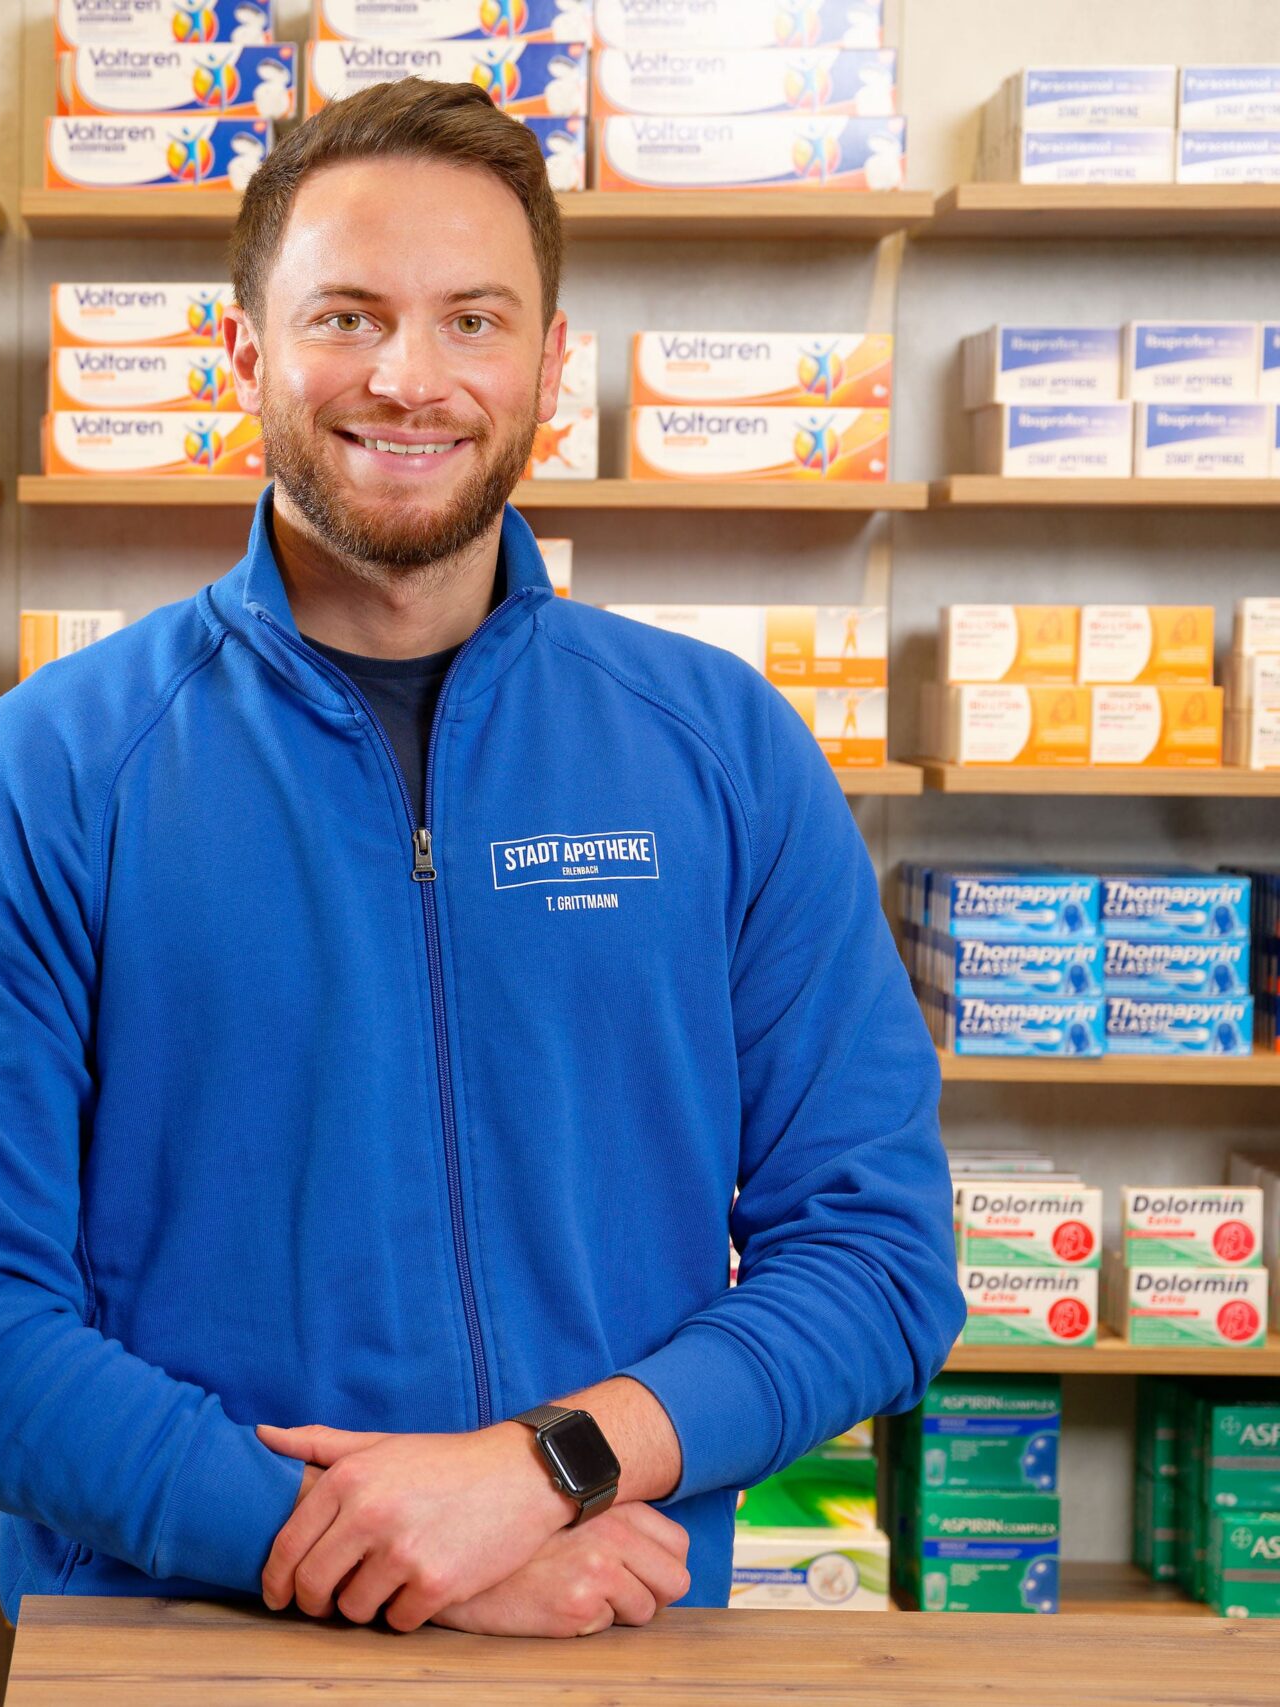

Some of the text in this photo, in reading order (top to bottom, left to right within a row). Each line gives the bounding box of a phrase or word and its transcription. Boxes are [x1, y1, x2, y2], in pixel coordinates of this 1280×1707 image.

[89, 48, 180, 68] Voltaren
[338, 45, 441, 67] Voltaren
[623, 51, 726, 73] Voltaren
[64, 123, 156, 142] Voltaren
[629, 120, 733, 142] Voltaren
[74, 288, 166, 307] Voltaren
[659, 337, 770, 360] Voltaren
[75, 353, 166, 371] Voltaren
[71, 416, 163, 435] Voltaren
[657, 411, 768, 435] Voltaren
[504, 838, 651, 871] STADT APOTHEKE
[562, 865, 599, 876] ERLENBACH
[546, 893, 619, 912] T. GRITTMANN
[955, 880, 1090, 905] Thomapyrin
[1104, 880, 1241, 906] Thomapyrin
[960, 939, 1096, 965] Thomapyrin
[1104, 939, 1241, 965] Thomapyrin
[961, 999, 1096, 1024] Thomapyrin
[1108, 998, 1244, 1023] Thomapyrin
[971, 1194, 1084, 1214] Dolormin
[1132, 1194, 1245, 1214] Dolormin
[968, 1271, 1080, 1292] Dolormin
[1136, 1272, 1249, 1293] Dolormin
